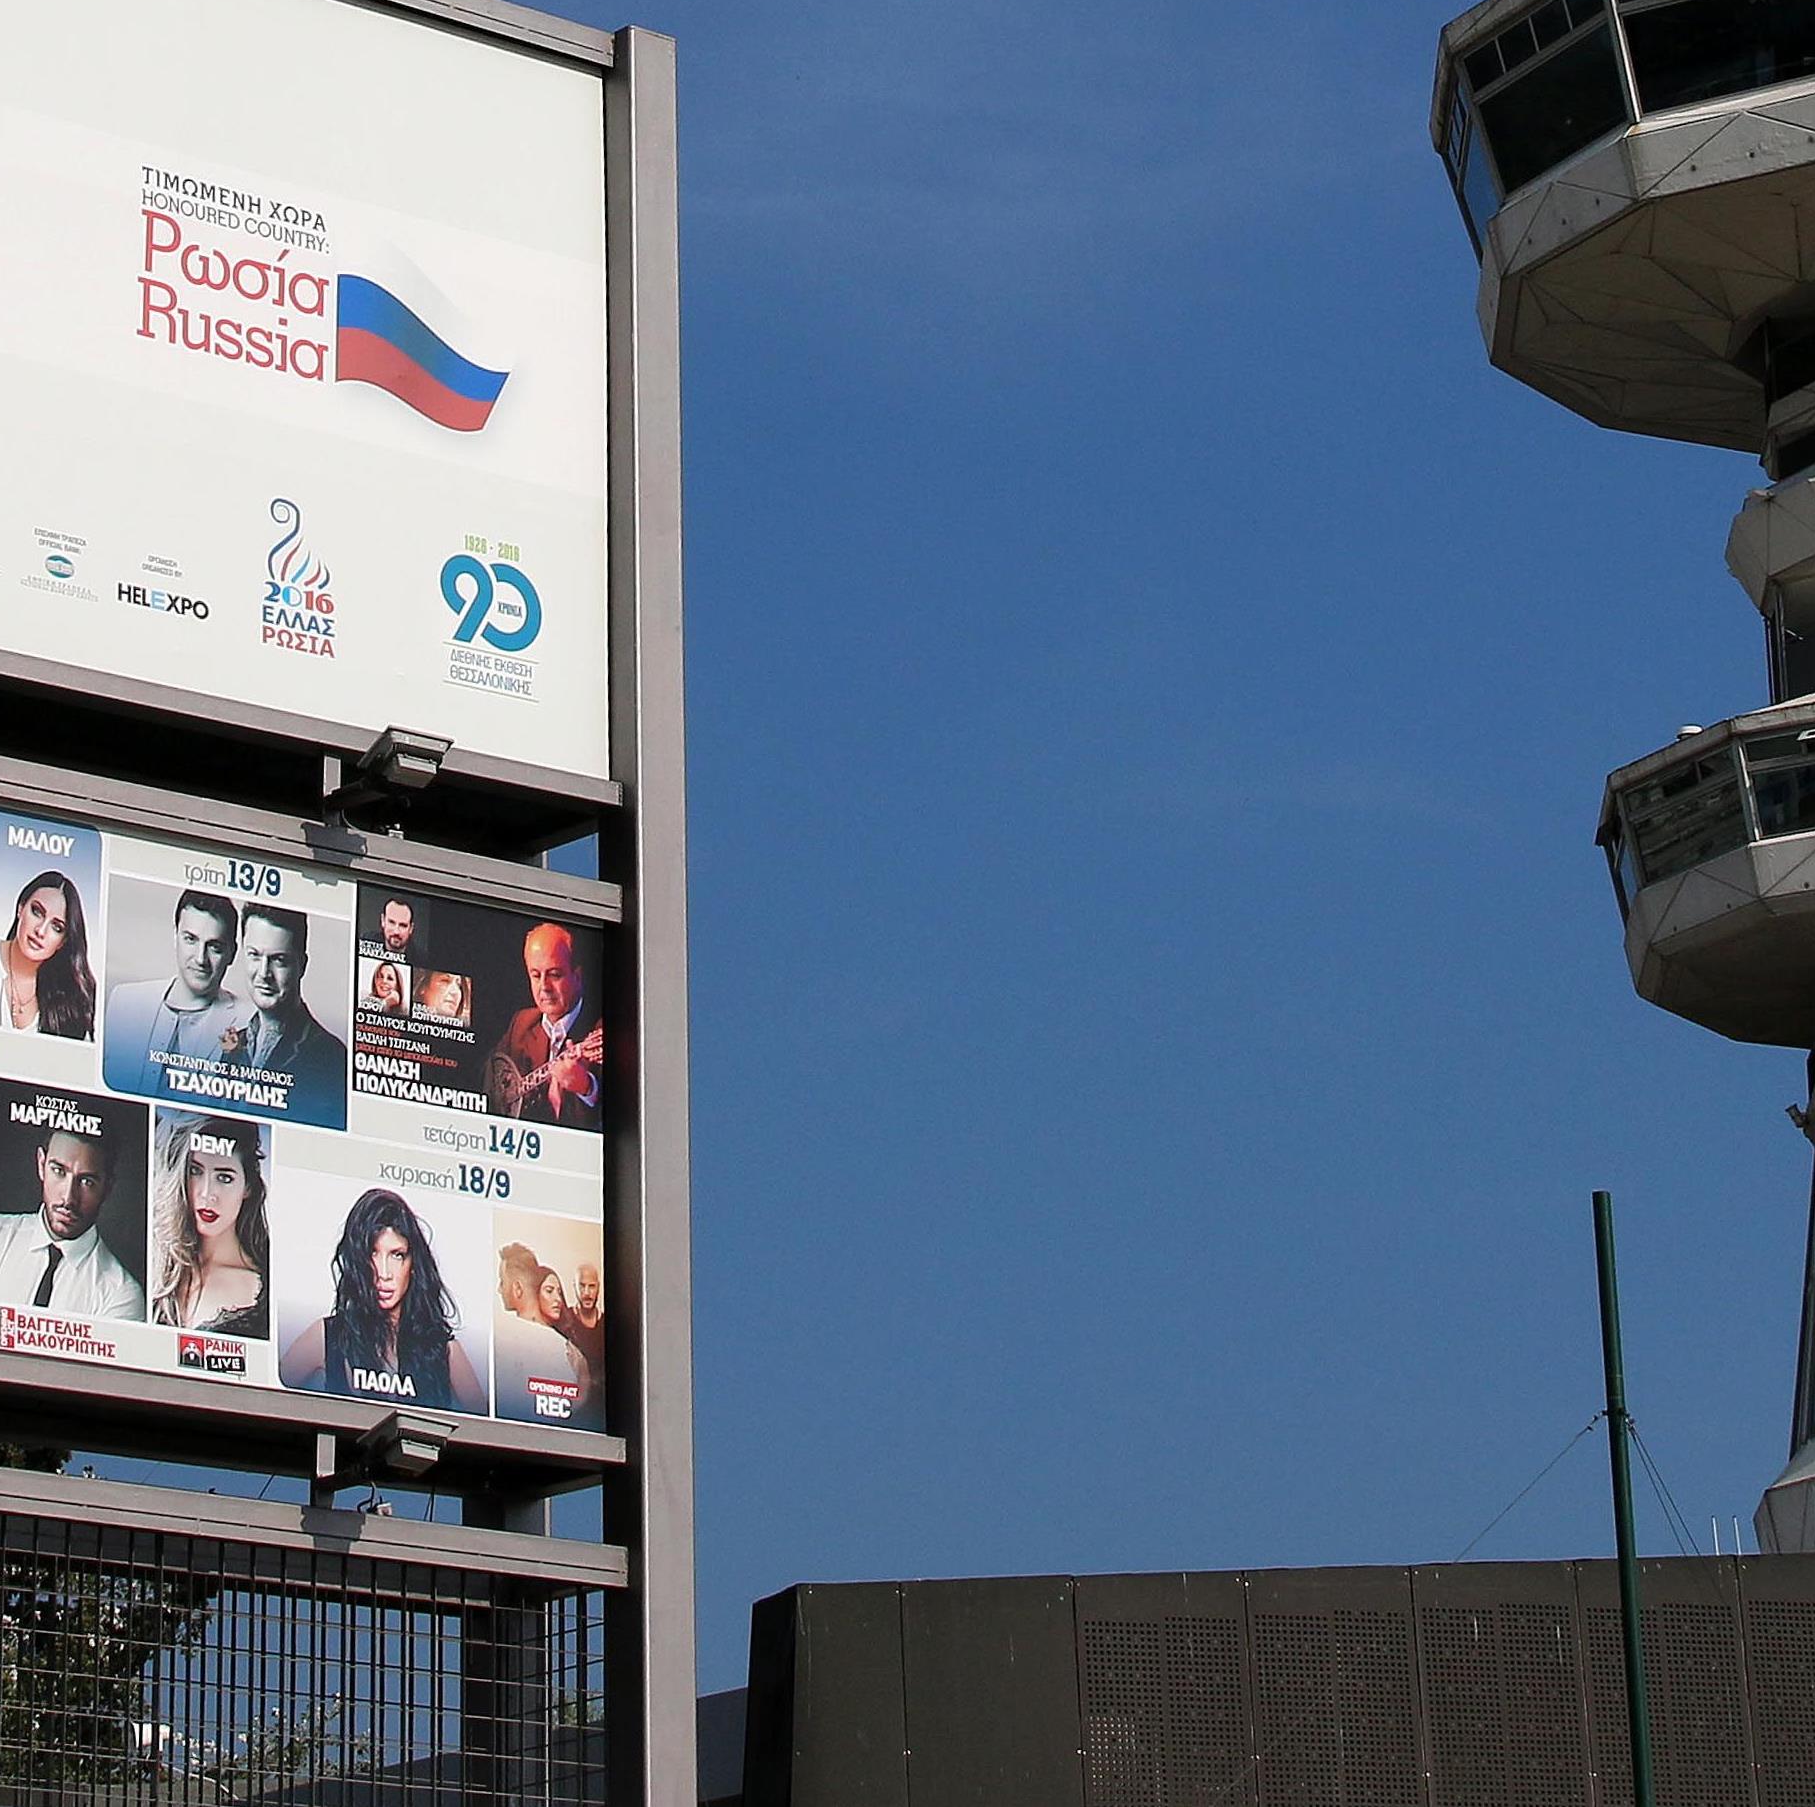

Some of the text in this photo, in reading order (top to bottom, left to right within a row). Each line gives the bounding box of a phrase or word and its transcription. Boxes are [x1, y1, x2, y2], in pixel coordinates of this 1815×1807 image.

[141, 166, 327, 232] ΤΙΜΩΜΕΝΗ ΧΩΡΑ
[141, 189, 330, 254] HONOURED COUNTRY:
[141, 209, 329, 317] Ρωσία
[137, 276, 328, 382] Russia
[117, 582, 210, 620] HELEXPO
[264, 581, 335, 615] 2016
[440, 554, 542, 652] 90
[262, 605, 335, 637] ΕΛΛΑΣ
[262, 625, 335, 659] ΡΩΣΙΑ
[450, 649, 532, 678] ΔΙΕΘΝΗΣ ΕΚΘΕΣΗ
[450, 665, 532, 695] ΘΕΣΣΑΛΟΝΙΚΗΣ
[7, 825, 74, 858] ΜΑΛΟΥ
[184, 859, 282, 897] τρίτη 13/9
[356, 1011, 365, 1023] Ο
[148, 1049, 228, 1077] ΚΩΝΣΤΑΝΤΙΝΟΣ
[240, 1065, 294, 1086] ΜΑΤΘΑΙΟΣ
[355, 1052, 421, 1081] ΘΑΝΑΣΗ
[35, 1095, 79, 1113] ΚΩΣΤΑΣ
[167, 1068, 288, 1110] ΤΣΑΧΟΥΡΙΔΗΣ
[356, 1073, 488, 1113] ΠΟΛΥΚΑΝΔΡΙΩΤΗ
[10, 1102, 102, 1137] ΜΑΡΤΑΚΗΣ
[190, 1132, 237, 1158] DEMY
[422, 1123, 541, 1160] τετάρτη 14/9
[378, 1164, 511, 1198] κυριακή 18/9
[17, 1315, 92, 1339] ΒΑΓΓΕΛΗΣ
[17, 1329, 116, 1359] ΚΑΚΟΥΡΙΩΤΗΣ
[205, 1339, 244, 1356] PANIK
[211, 1357, 241, 1372] LIVE
[353, 1368, 416, 1397] ΠΑΟΛΑ
[529, 1381, 578, 1397] OPENING ACT
[536, 1394, 571, 1419] REC
